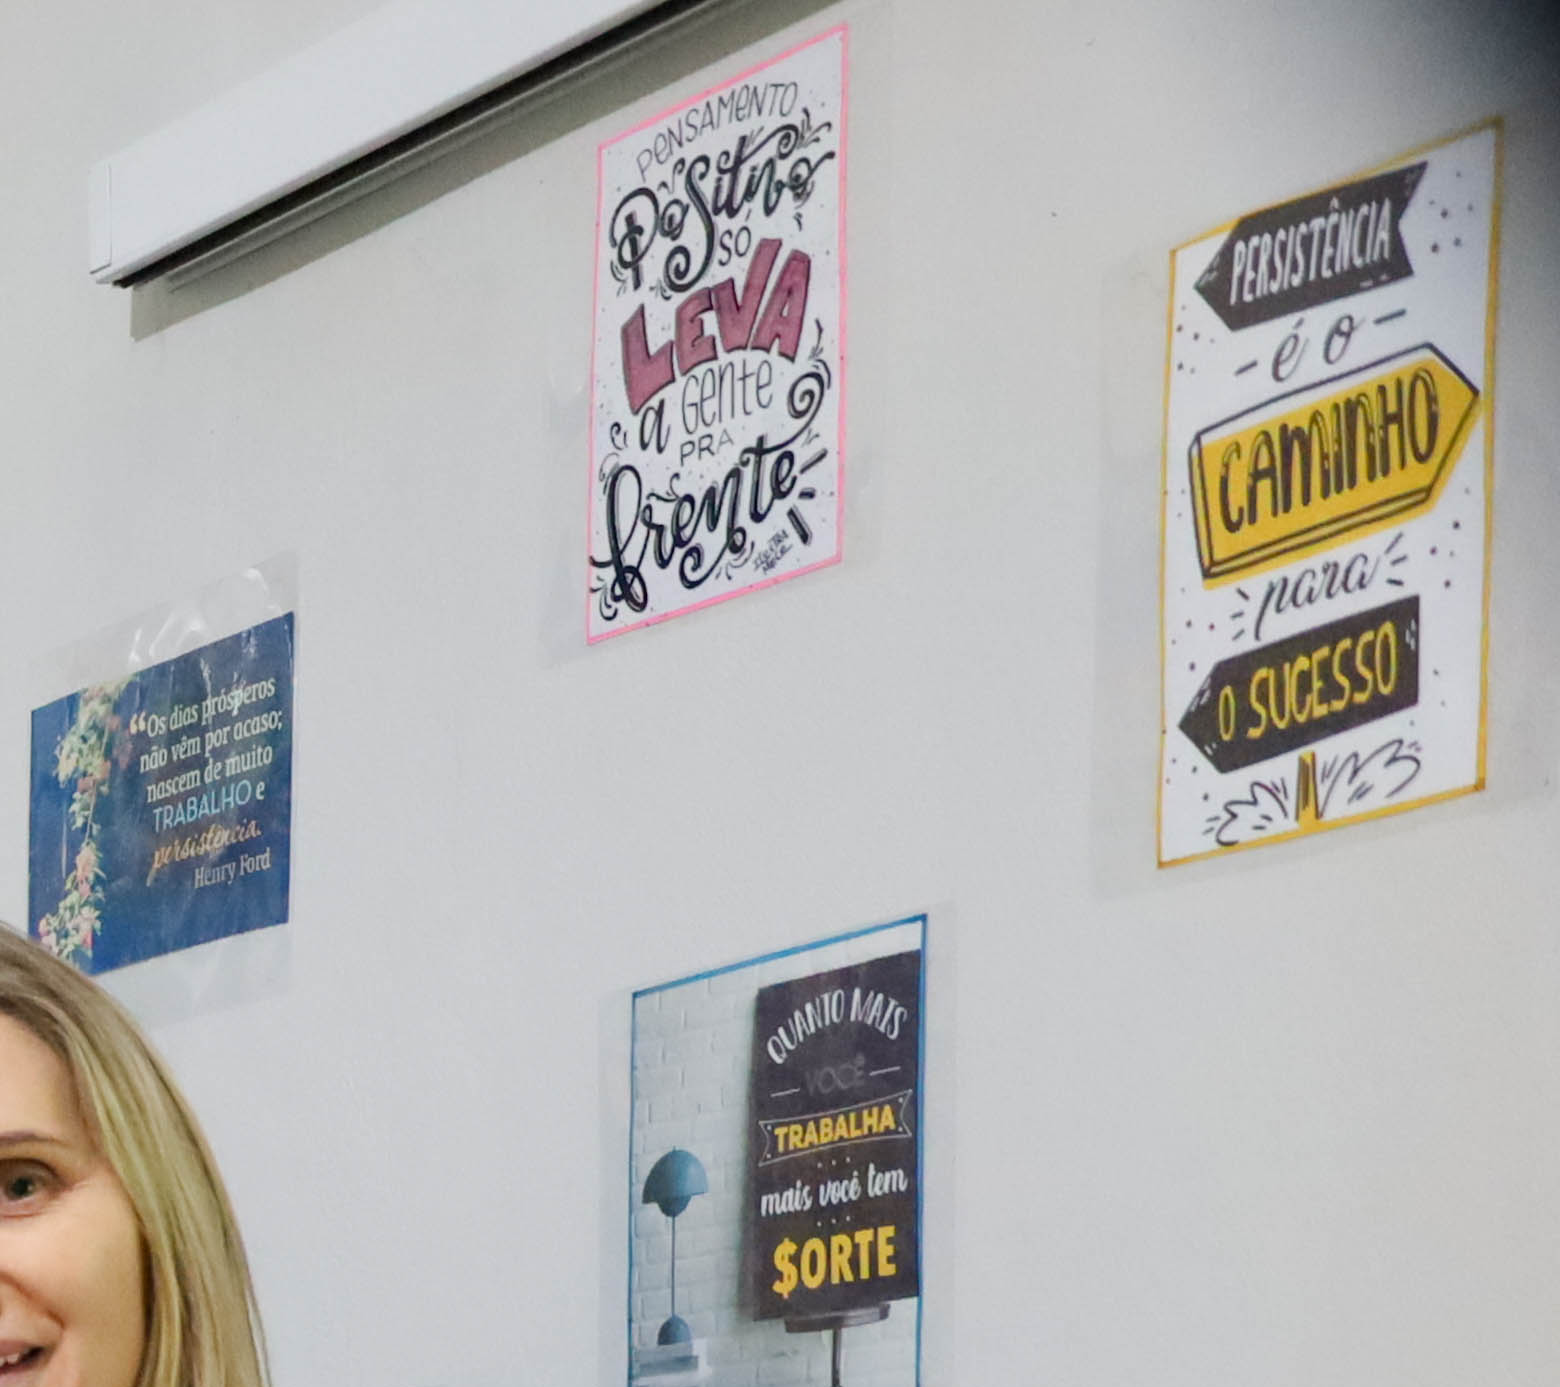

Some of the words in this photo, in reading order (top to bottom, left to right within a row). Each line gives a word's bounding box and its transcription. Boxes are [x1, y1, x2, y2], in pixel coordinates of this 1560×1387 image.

[1228, 196, 1396, 308] PERSISTÊNCIA
[621, 238, 811, 416] LEVA
[680, 428, 735, 467] PRA
[1255, 549, 1379, 642] para
[170, 704, 198, 731] dias
[201, 677, 276, 726] prósperos
[1246, 620, 1398, 741] SUCESSO
[140, 746, 168, 774] não
[171, 735, 200, 762] vêm
[204, 726, 231, 758] por
[233, 711, 283, 740] acaso;
[146, 769, 201, 803] nascem
[203, 758, 222, 784] de
[224, 744, 274, 775] muito
[152, 779, 252, 833] TRABALHO
[194, 859, 236, 890] Henry
[239, 848, 271, 877] Ford
[765, 989, 846, 1066] QUANTO
[849, 986, 909, 1042] MAIS
[773, 1103, 896, 1154] TRABALHA
[759, 1180, 814, 1217] mais
[818, 1169, 863, 1207] você
[866, 1162, 909, 1198] tem
[771, 1224, 897, 1300] $ORTE
